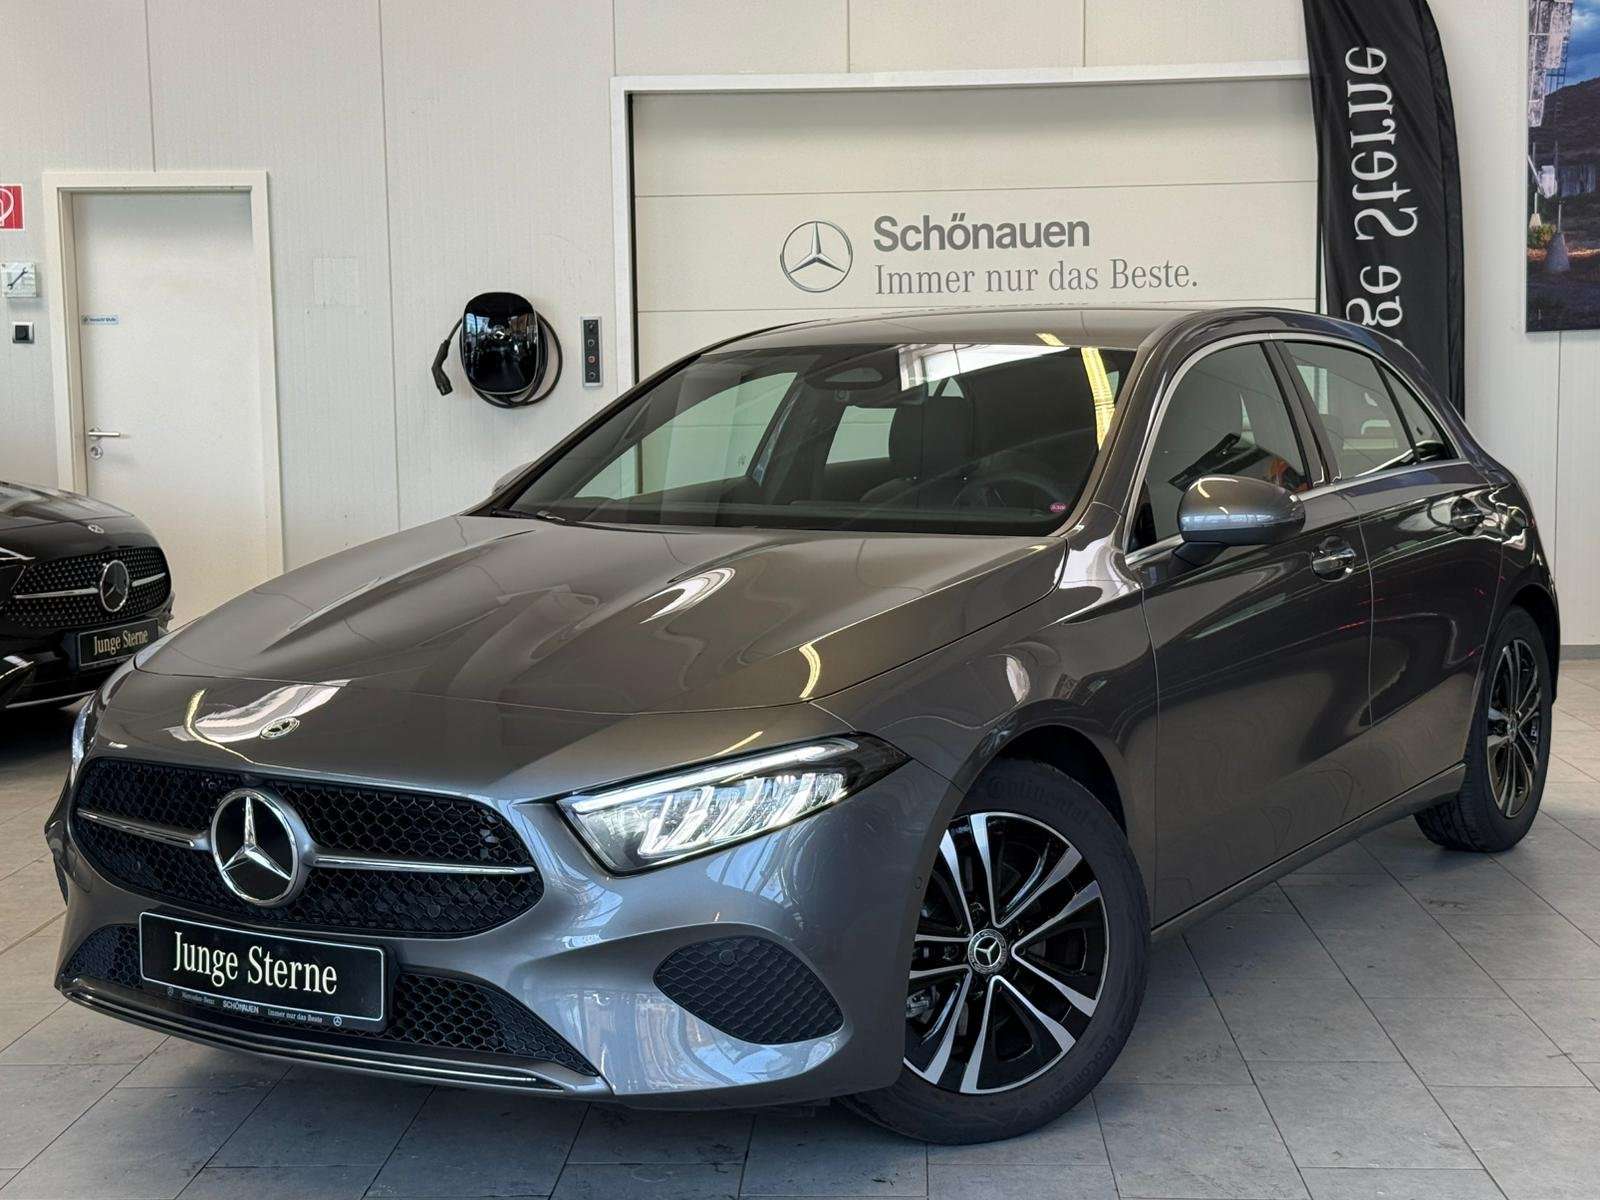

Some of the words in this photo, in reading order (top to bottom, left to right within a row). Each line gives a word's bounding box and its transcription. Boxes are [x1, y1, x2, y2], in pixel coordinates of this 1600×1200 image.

[873, 212, 1090, 252] Schönauen
[875, 264, 975, 295] Immer
[985, 268, 1039, 293] nur
[1048, 260, 1099, 291] das
[1109, 258, 1198, 289] Beste.
[93, 635, 121, 656] Junge
[122, 629, 148, 648] Sterne
[173, 931, 238, 987] Junge
[247, 946, 338, 995] Sterne
